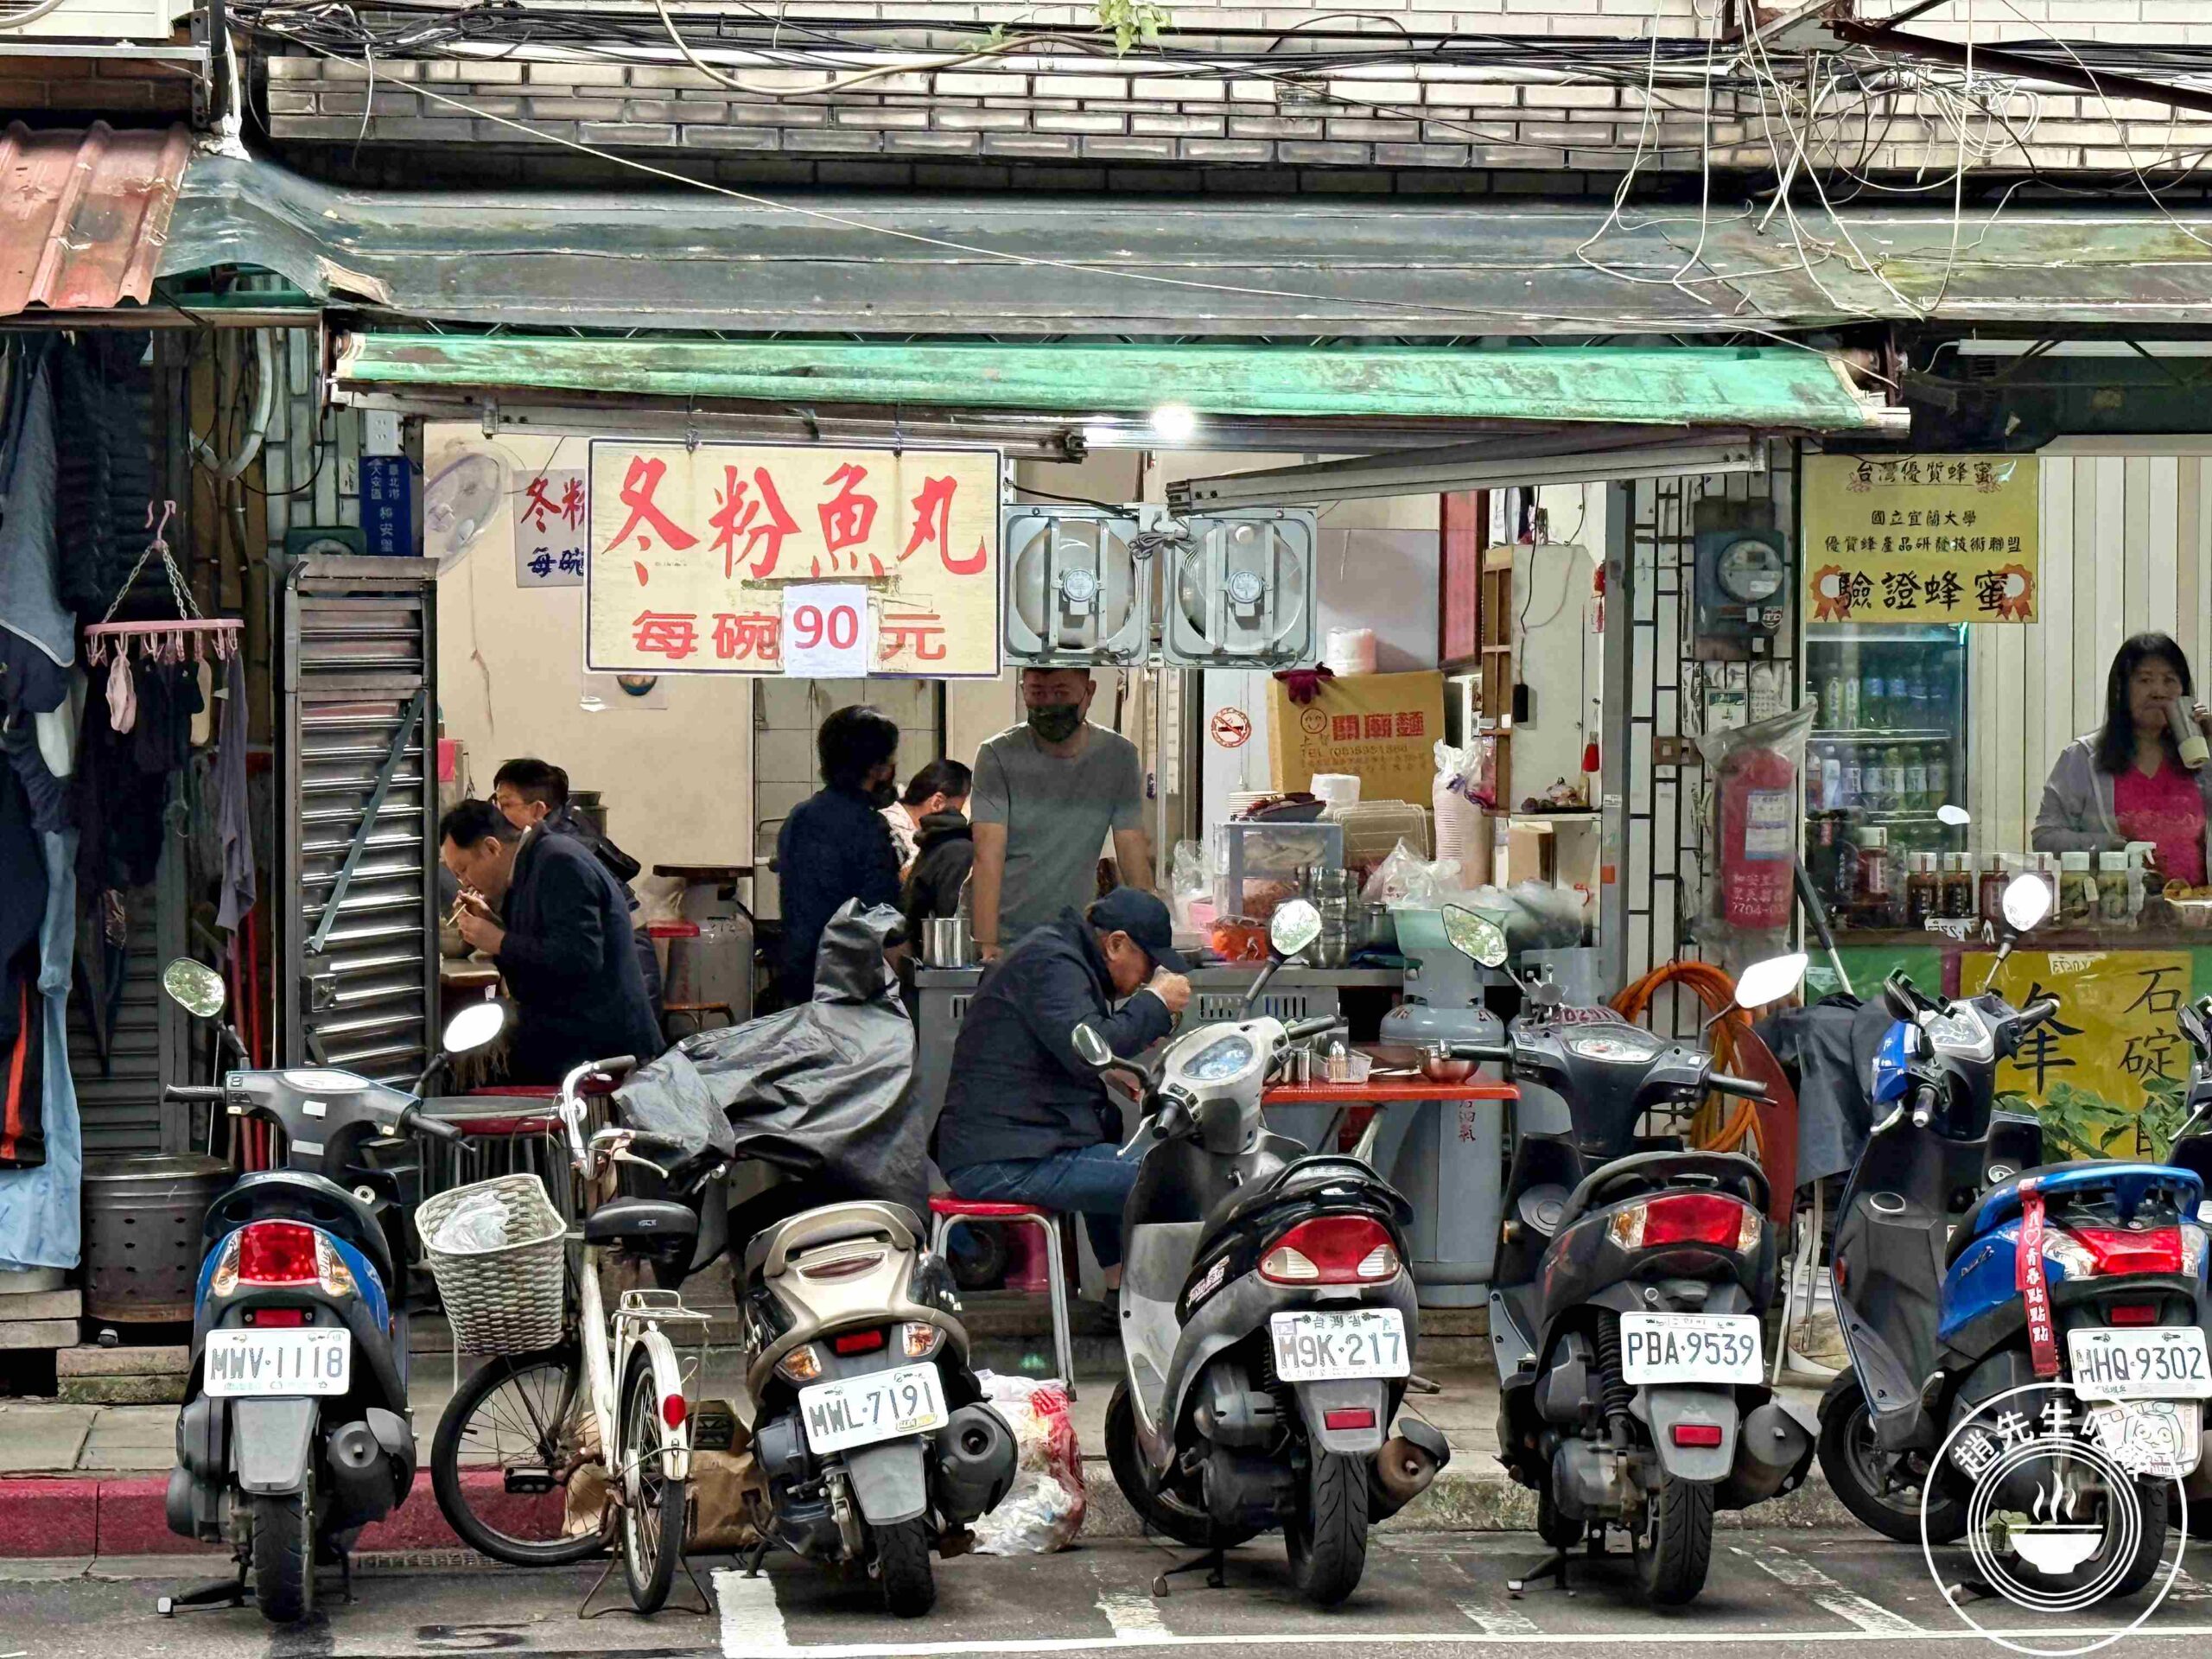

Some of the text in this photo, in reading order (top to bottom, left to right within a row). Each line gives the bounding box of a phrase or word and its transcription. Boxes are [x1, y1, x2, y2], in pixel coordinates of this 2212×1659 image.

[1857, 461, 1993, 483] 台灣優質蜂蜜
[601, 454, 987, 587] 冬粉魚丸
[1872, 509, 1977, 526] 國立宜蘭大學
[1834, 569, 2008, 612] 驗證蜂蜜
